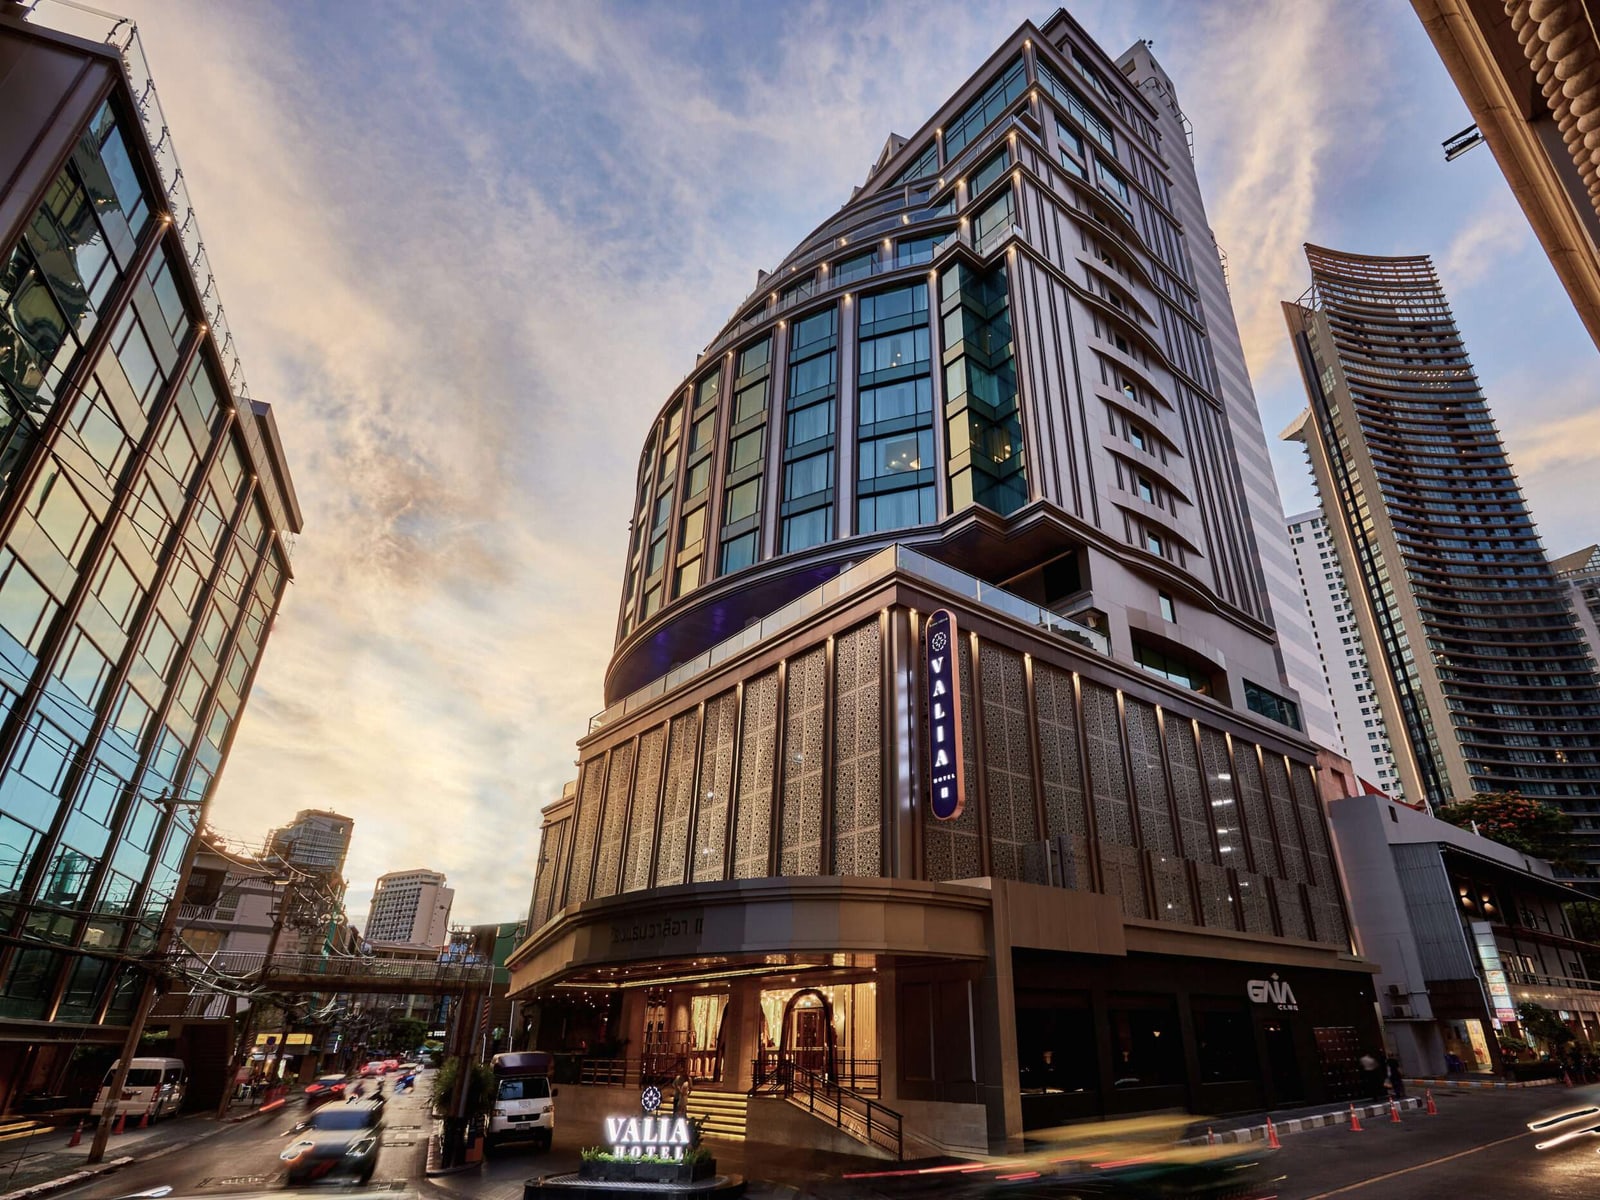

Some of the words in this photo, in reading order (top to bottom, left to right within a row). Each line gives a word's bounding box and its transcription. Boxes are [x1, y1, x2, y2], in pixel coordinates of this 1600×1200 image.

[931, 656, 950, 768] VALIA
[933, 773, 956, 784] HOTEL
[606, 1117, 690, 1144] VALIA
[614, 1146, 684, 1162] HOTEL
